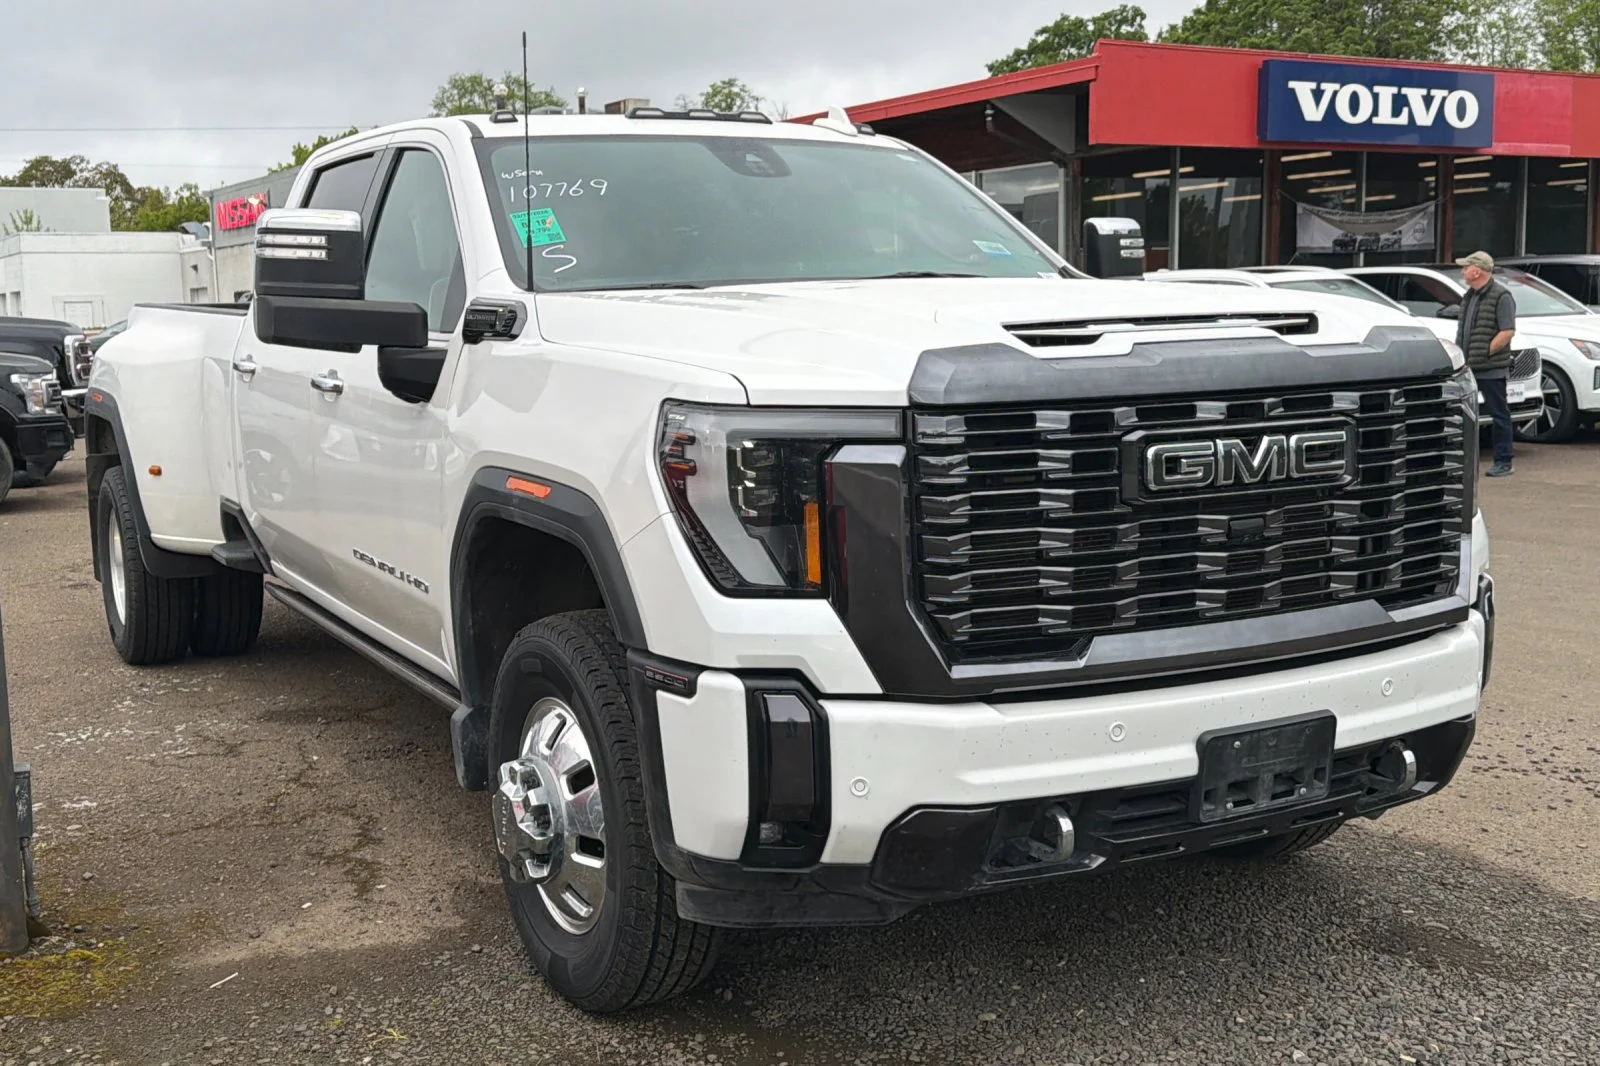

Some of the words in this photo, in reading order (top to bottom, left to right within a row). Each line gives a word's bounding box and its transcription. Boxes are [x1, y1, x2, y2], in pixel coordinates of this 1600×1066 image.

[1288, 81, 1479, 129] VOLVO
[510, 179, 608, 203] 107769
[1146, 430, 1347, 491] GMC
